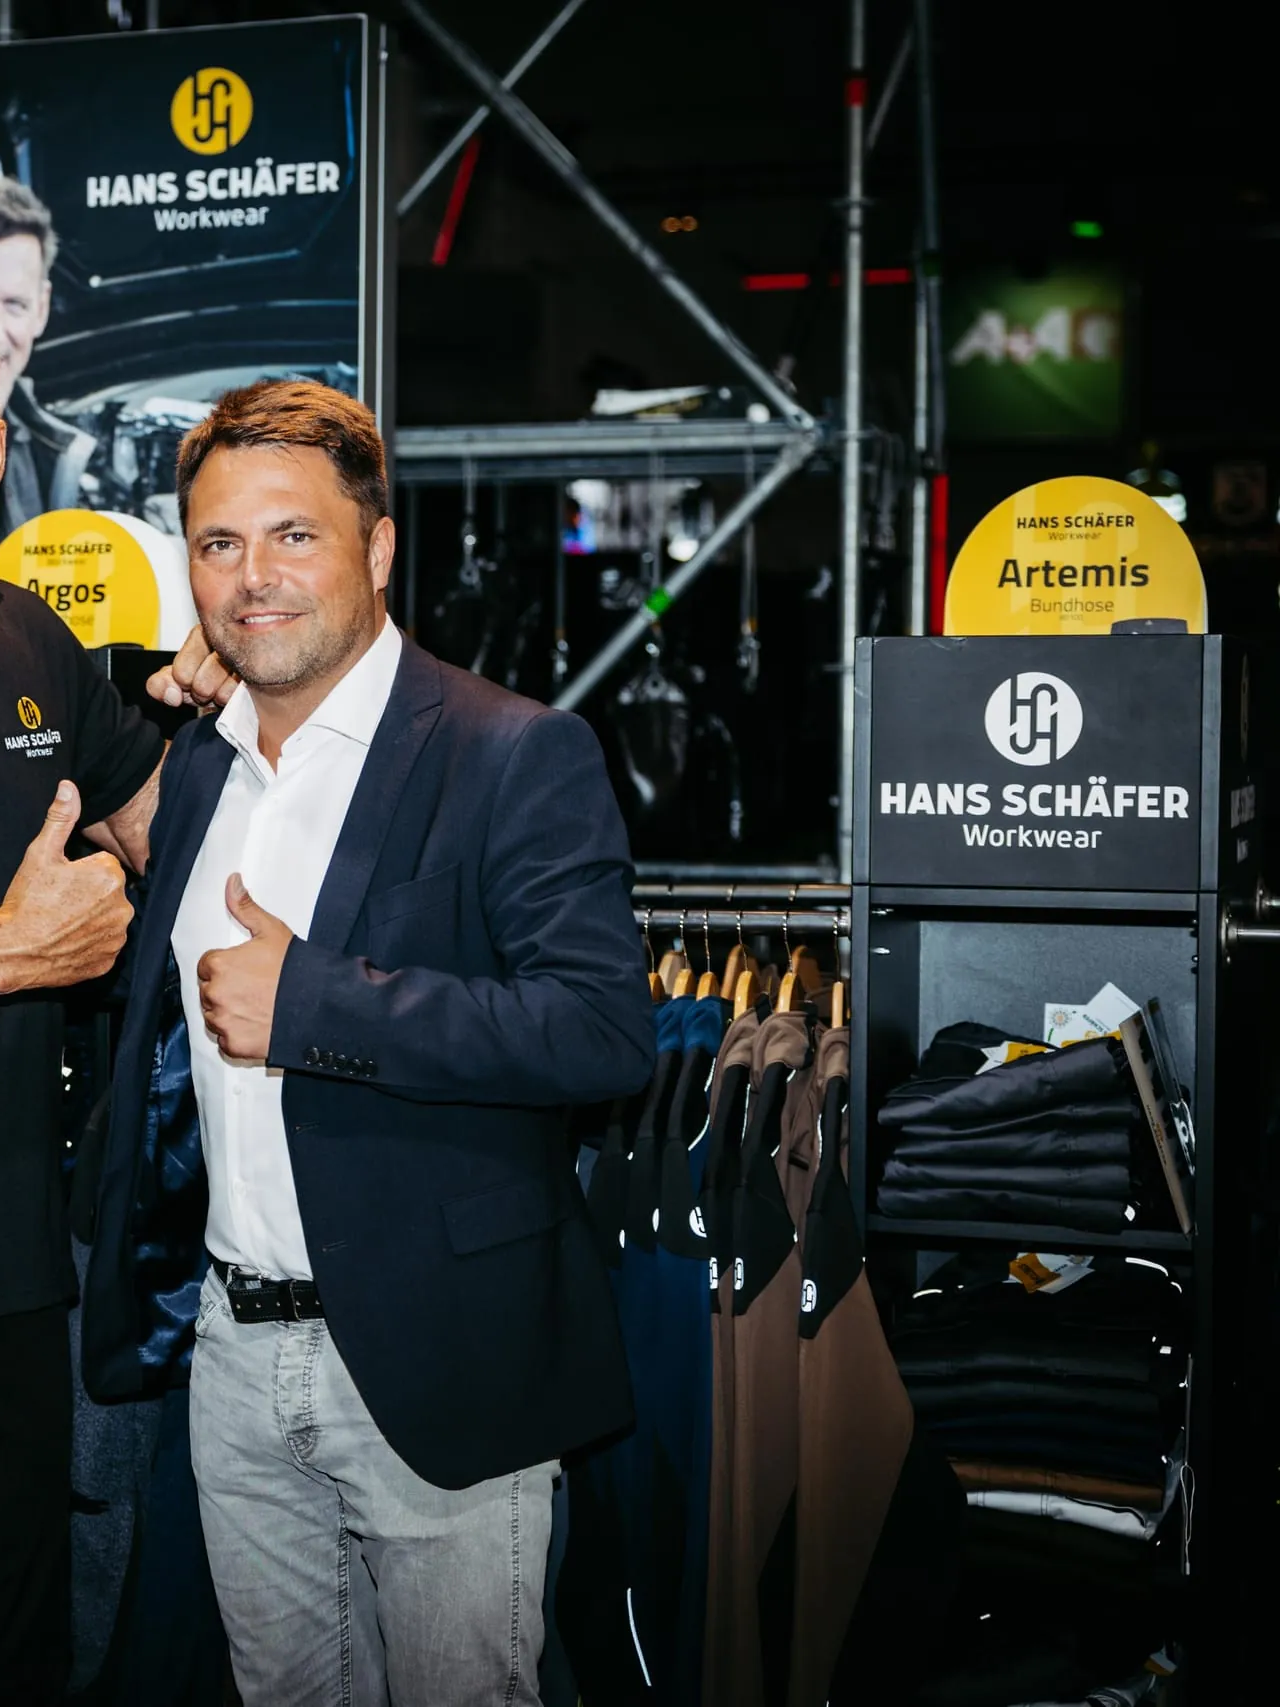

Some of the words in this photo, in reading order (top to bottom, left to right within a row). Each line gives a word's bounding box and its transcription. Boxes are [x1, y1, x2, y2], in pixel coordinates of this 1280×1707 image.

[86, 171, 180, 208] HANS
[185, 157, 340, 202] SCHÄFER
[153, 206, 270, 232] Workwear
[1016, 516, 1060, 529] HANS
[1063, 512, 1135, 529] SCHÄFER
[24, 544, 56, 555] HANS
[59, 541, 113, 555] SCHÄFER
[1048, 531, 1103, 541] Workwear
[997, 556, 1150, 588] Artemis
[27, 578, 107, 612] Argos
[1030, 597, 1115, 613] Bundhose
[4, 734, 30, 750] HANS
[880, 782, 992, 816] HANS
[1001, 775, 1189, 819] SCHÄFER
[962, 823, 1103, 849] Workwear
